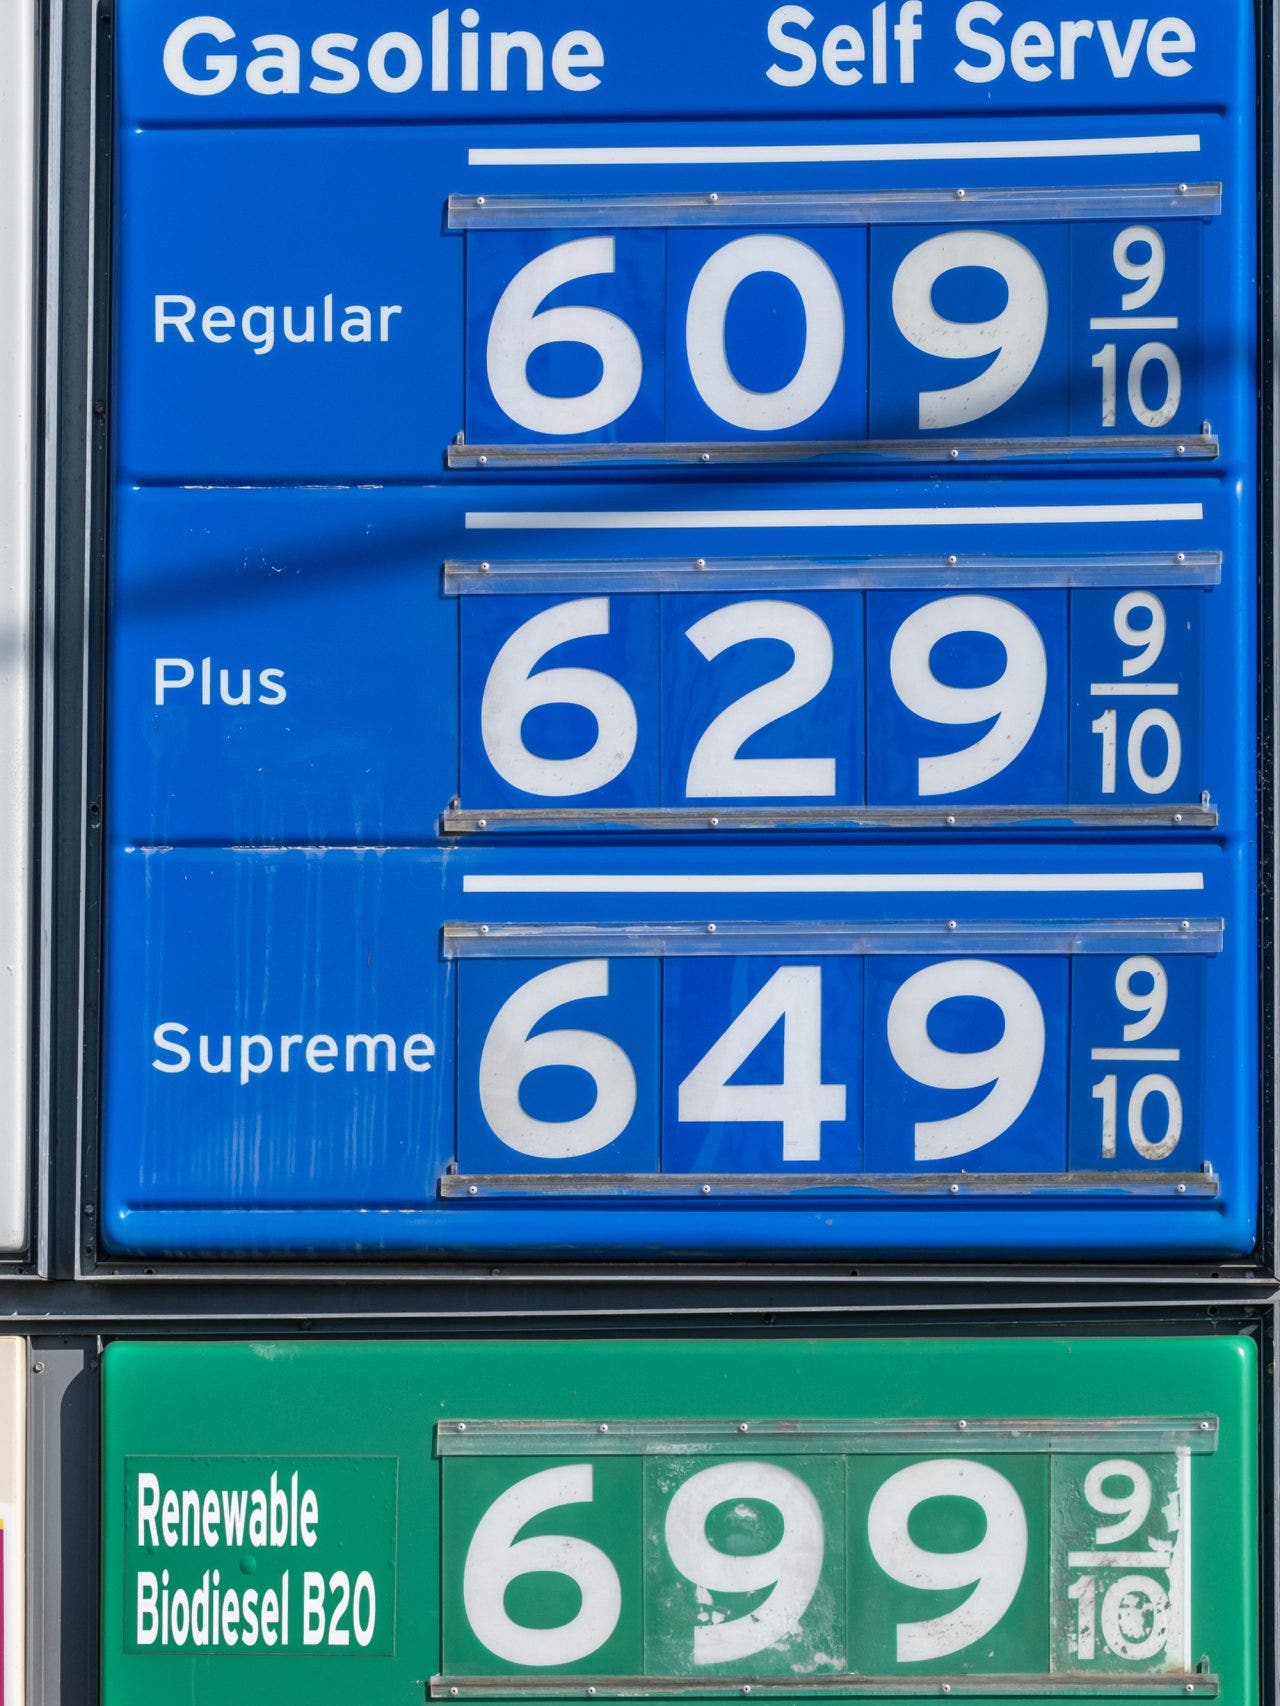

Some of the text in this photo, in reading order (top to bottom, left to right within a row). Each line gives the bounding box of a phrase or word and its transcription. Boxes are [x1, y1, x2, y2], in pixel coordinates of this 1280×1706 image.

[162, 0, 1196, 96] Gasoline Self Serve
[1112, 225, 1166, 311] 9
[154, 293, 403, 355] Regular
[486, 229, 1049, 435] 609
[1091, 341, 1182, 428] 10
[1113, 591, 1166, 677] 9
[155, 656, 287, 706] Plus
[480, 594, 1048, 798] 629
[1091, 707, 1182, 795] 10
[1115, 955, 1168, 1042] 9
[151, 1022, 436, 1086] Supreme
[478, 958, 1046, 1162] 649
[1092, 1073, 1183, 1160] 10
[137, 1470, 319, 1548] Renewable
[1084, 1458, 1152, 1545] 9
[462, 1459, 1029, 1666] 699
[136, 1569, 376, 1647] Biodiesel B20
[1067, 1574, 1170, 1660] 10
